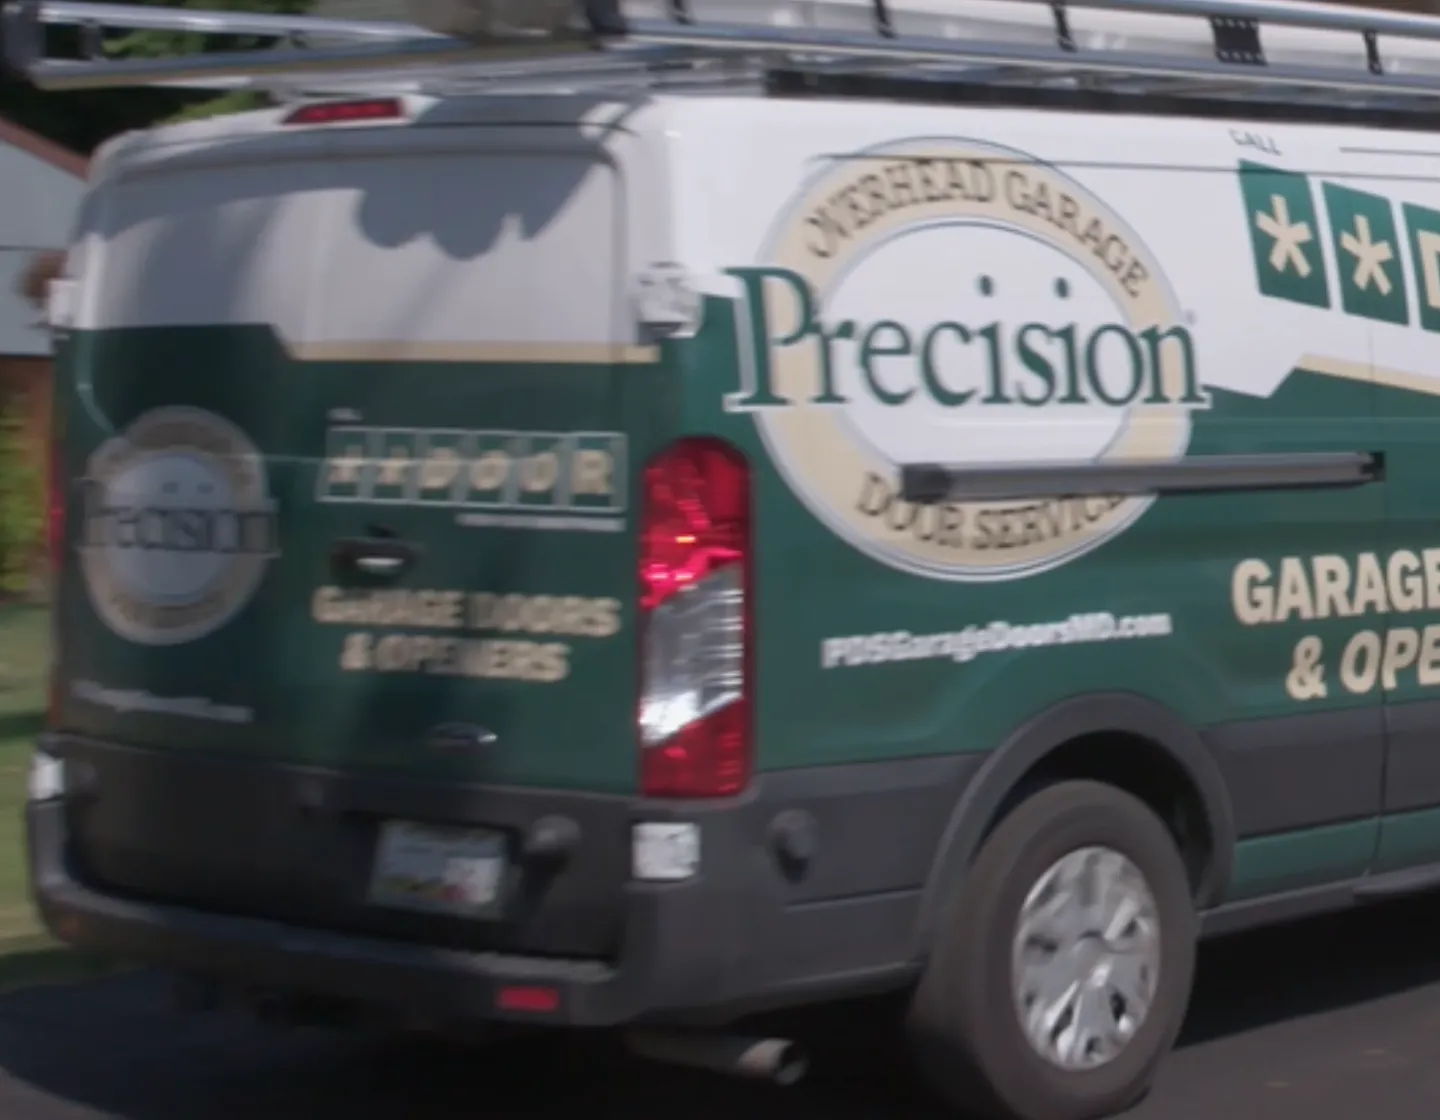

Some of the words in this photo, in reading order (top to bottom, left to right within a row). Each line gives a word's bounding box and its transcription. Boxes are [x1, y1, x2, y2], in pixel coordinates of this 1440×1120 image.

[1228, 128, 1283, 156] CALL
[804, 157, 996, 259] OVERHEAD
[1004, 170, 1148, 299] GARAGE
[722, 266, 1213, 412] Precision
[856, 472, 964, 548] DOOR
[1285, 635, 1328, 701] &
